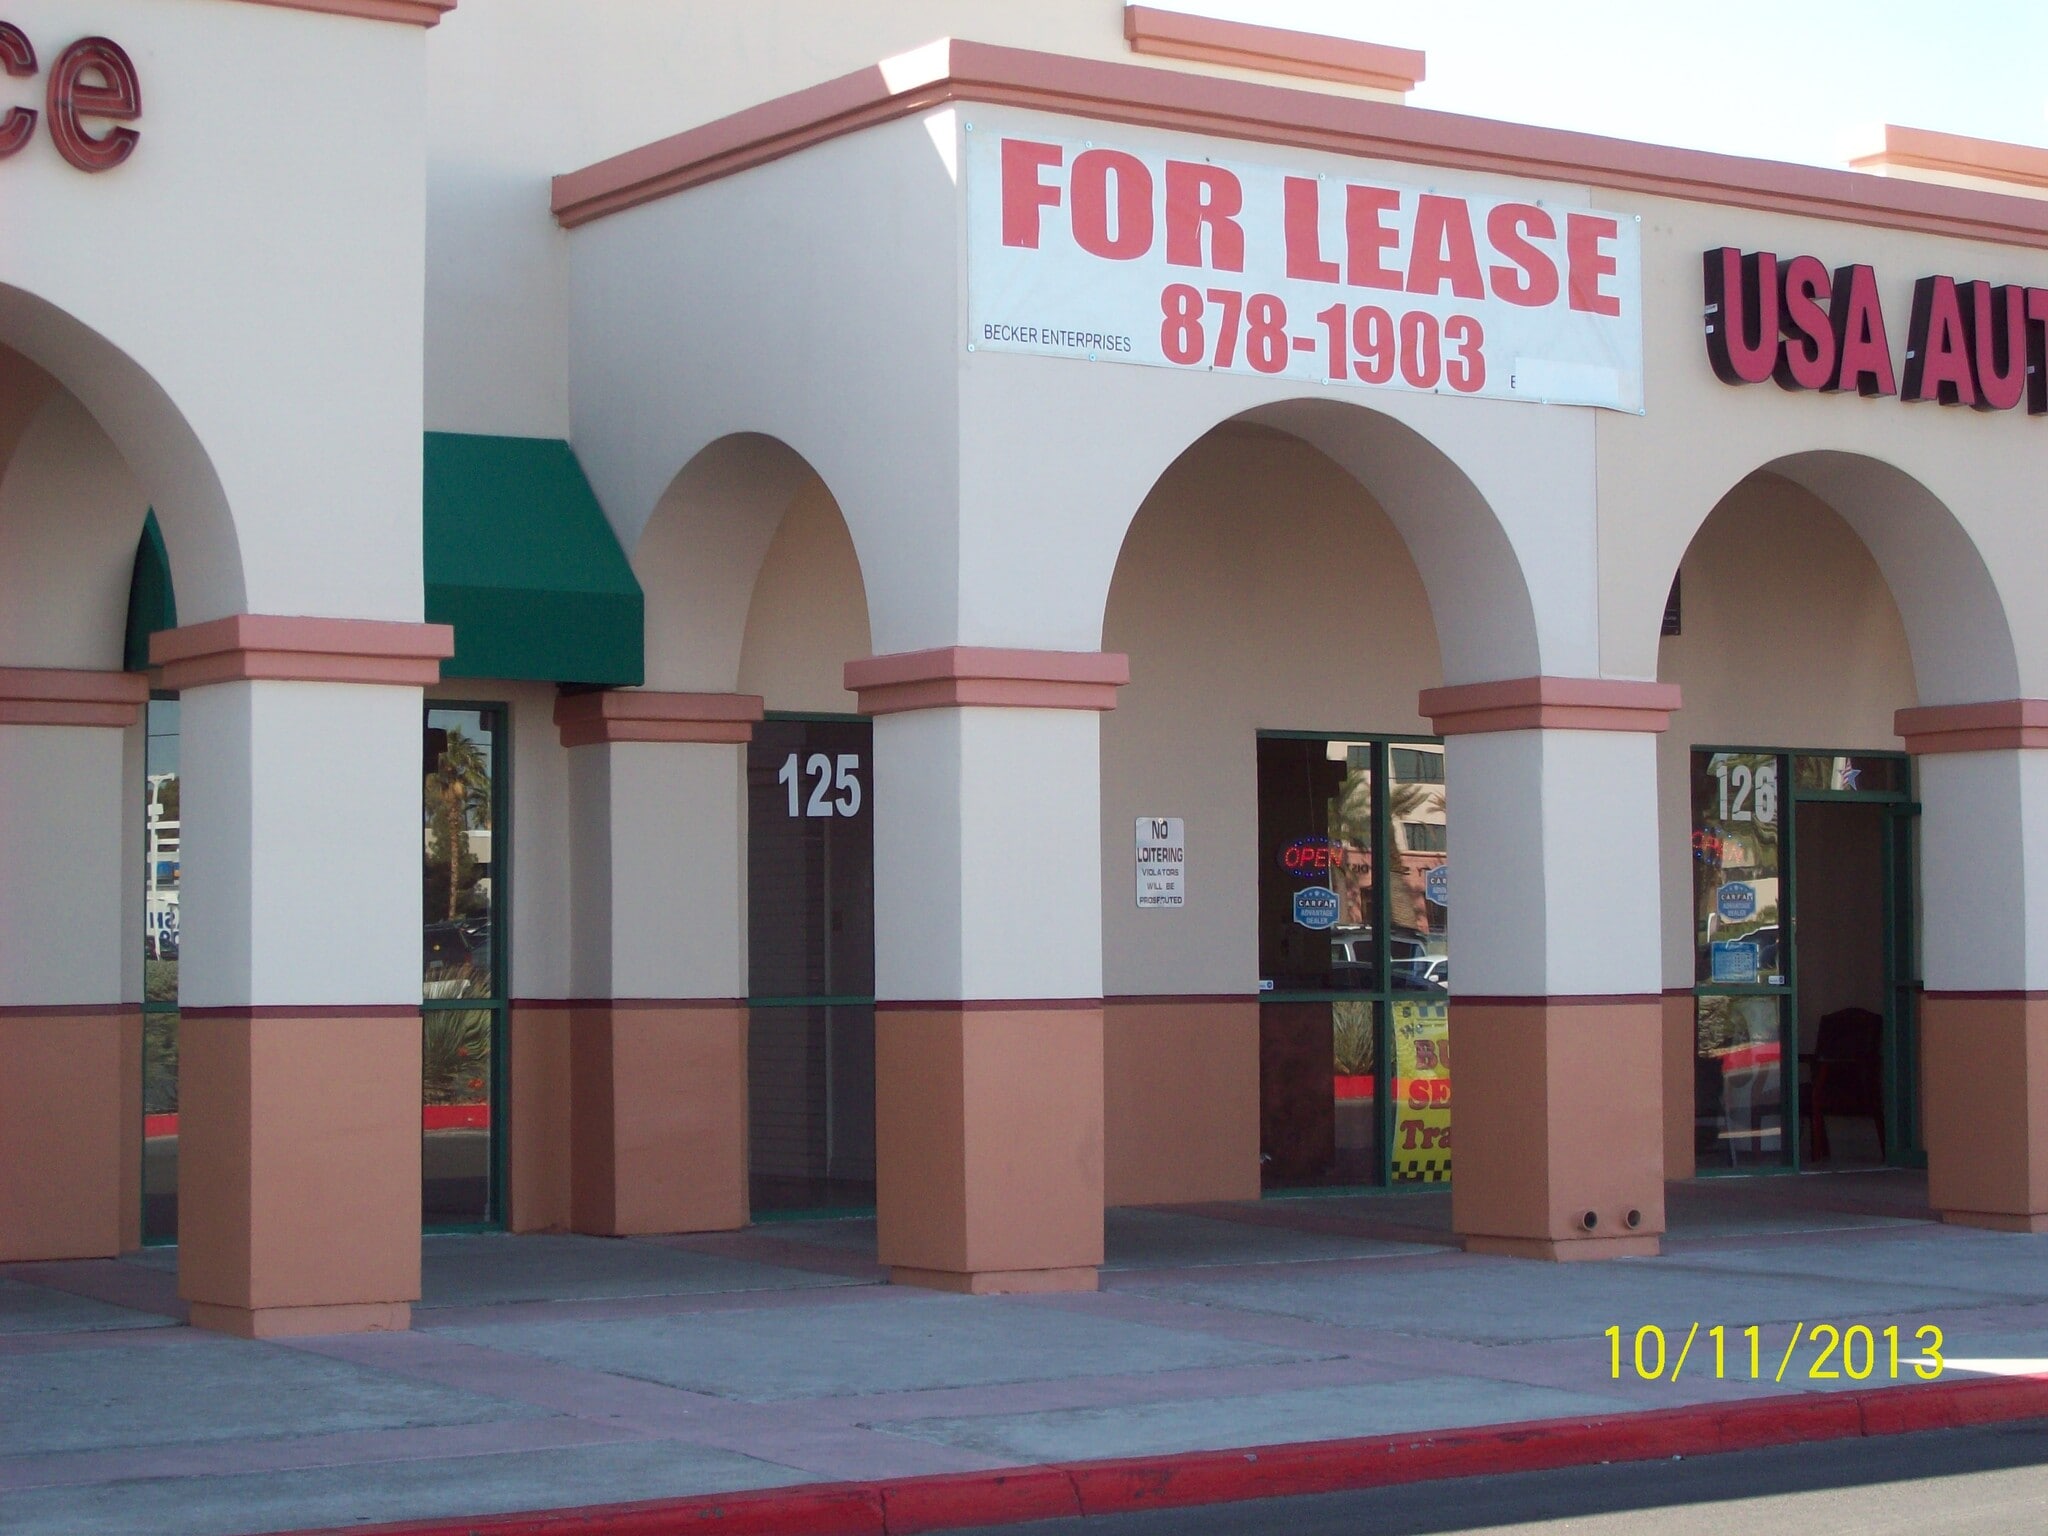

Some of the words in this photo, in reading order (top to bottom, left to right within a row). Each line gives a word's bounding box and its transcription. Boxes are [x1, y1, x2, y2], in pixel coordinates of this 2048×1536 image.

[1001, 138, 1245, 273] FOR
[1283, 176, 1621, 318] LEASE
[1703, 247, 1897, 398] USA
[984, 323, 1038, 343] BECKER
[1041, 328, 1132, 352] ENTERPRISES
[1161, 283, 1486, 393] 878-1903
[779, 753, 861, 817] 125
[1716, 765, 1775, 822] 126
[1151, 820, 1168, 839] NO
[1137, 847, 1183, 862] LOITERING
[1285, 846, 1343, 867] OPEN
[1142, 868, 1179, 876] VIOLATORS
[1146, 882, 1162, 890] WILL
[1166, 882, 1175, 890] BE
